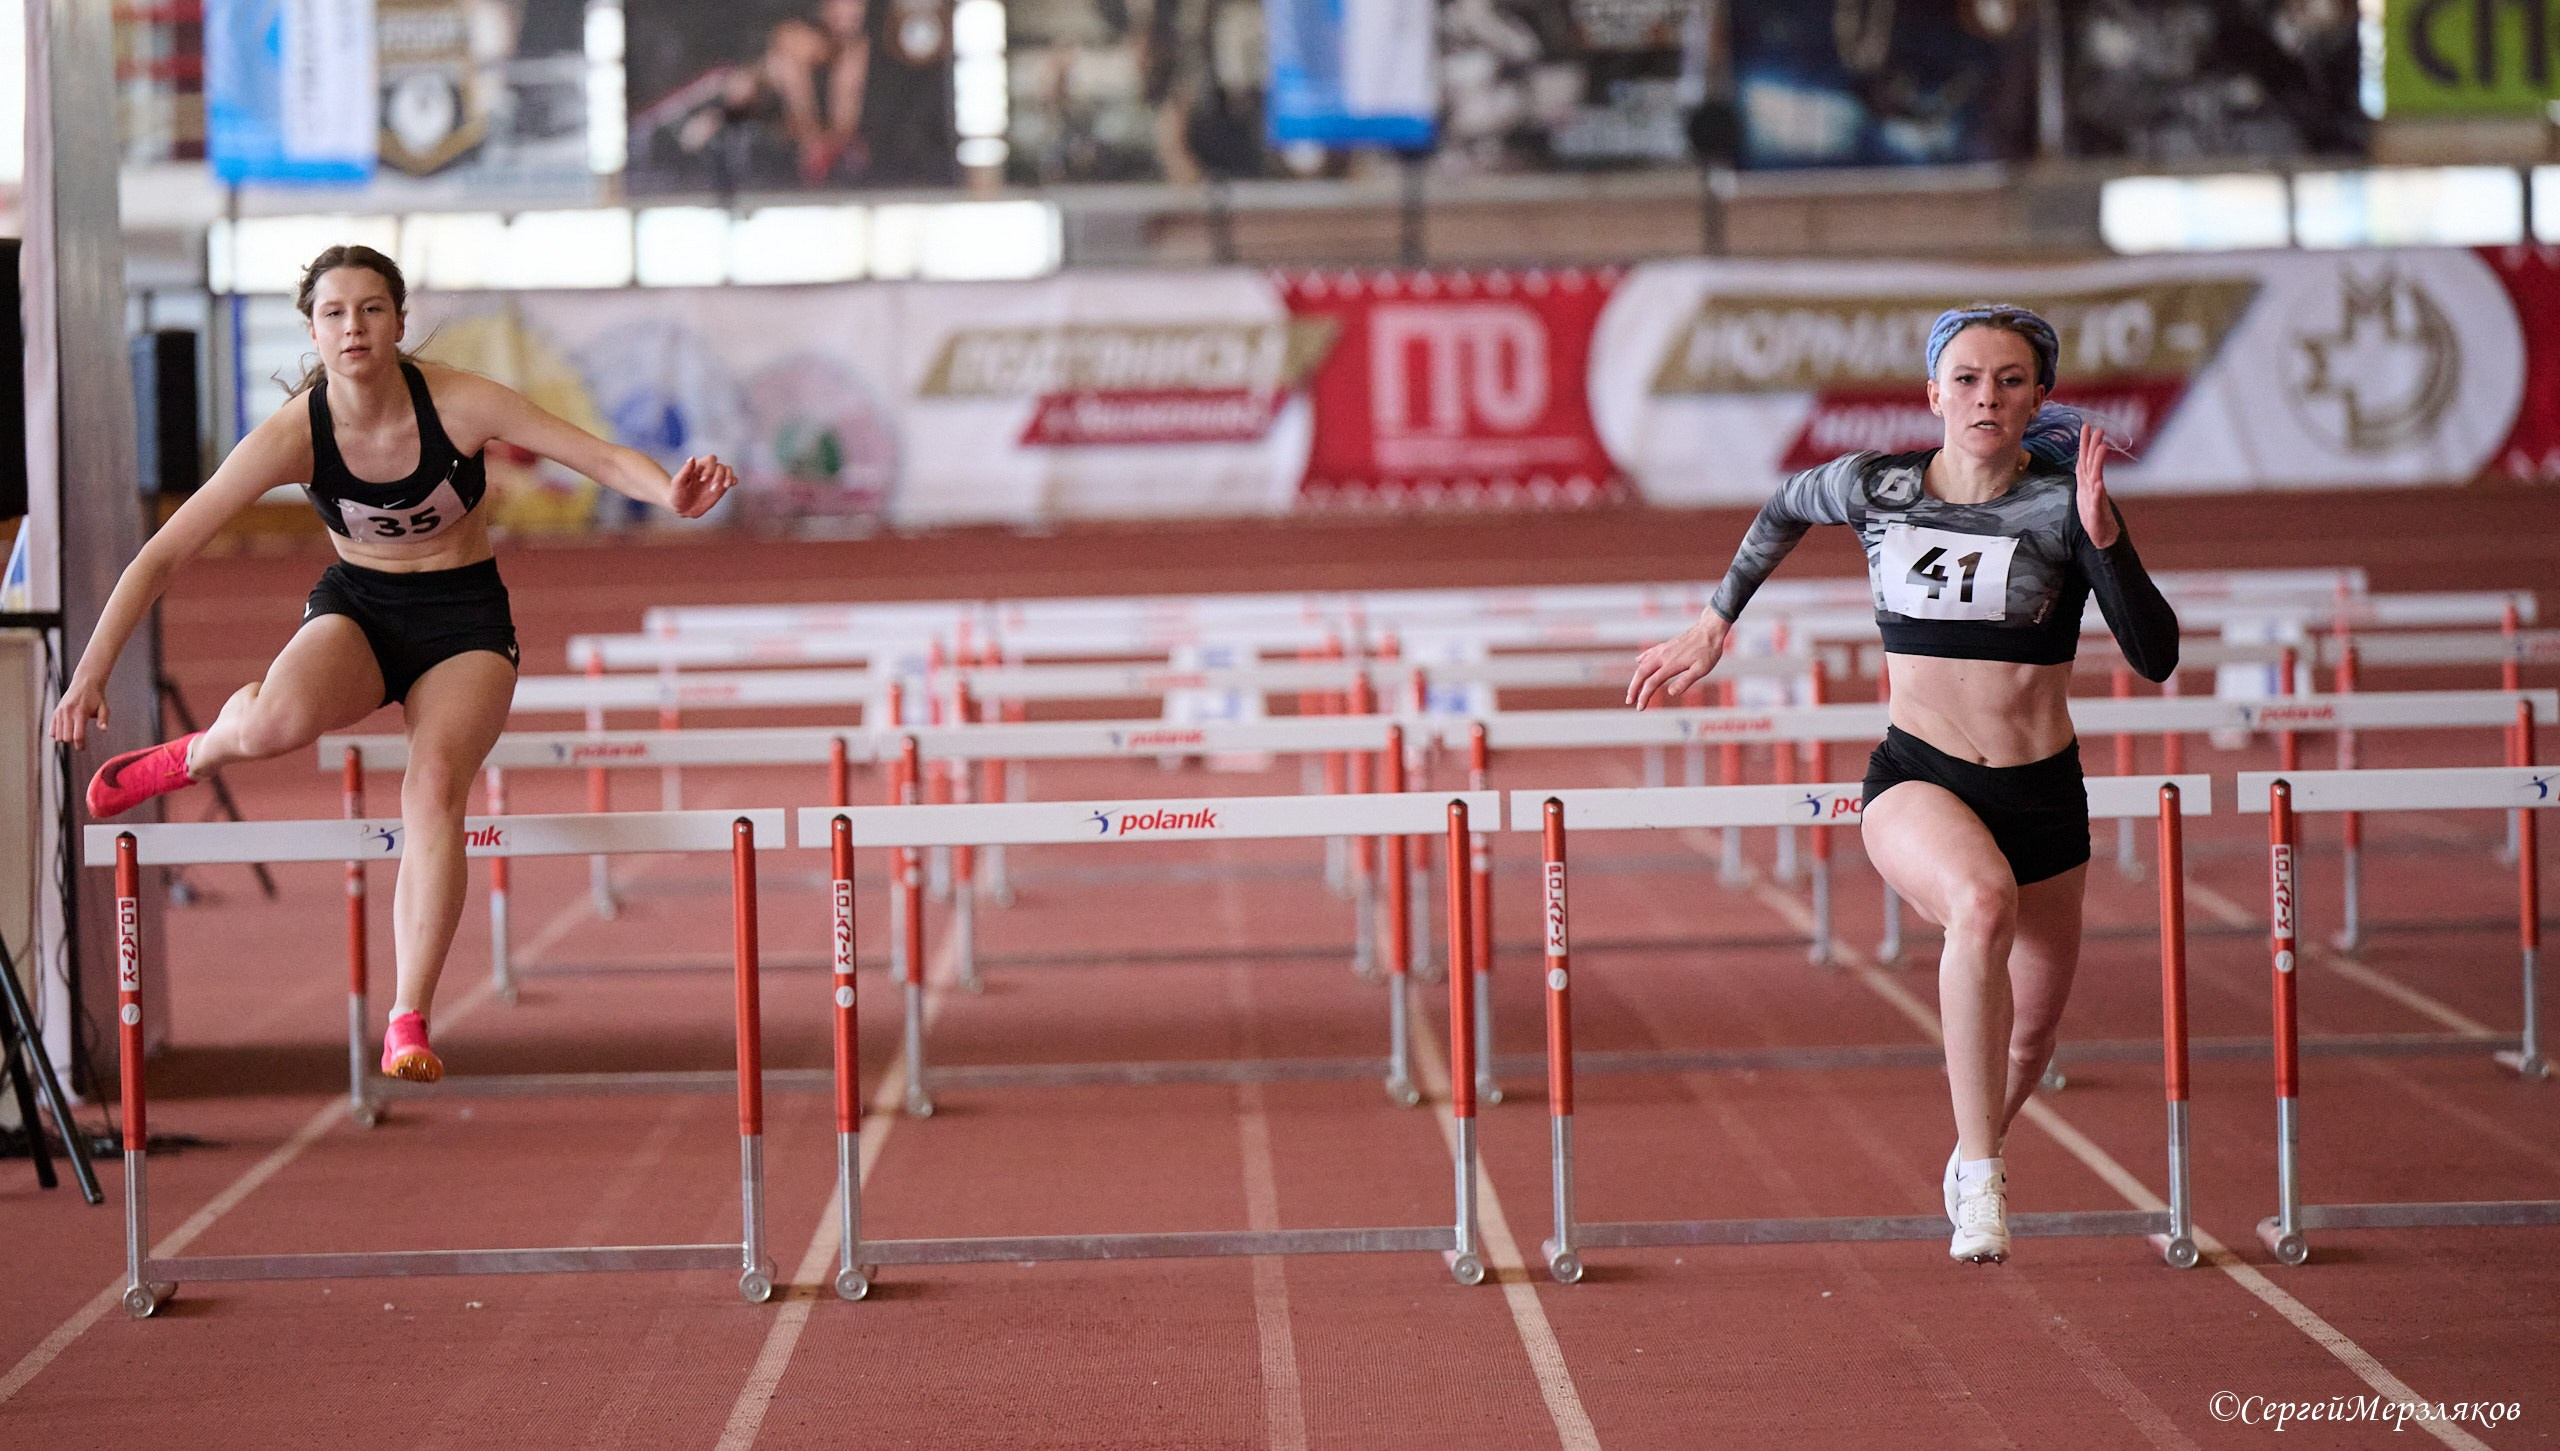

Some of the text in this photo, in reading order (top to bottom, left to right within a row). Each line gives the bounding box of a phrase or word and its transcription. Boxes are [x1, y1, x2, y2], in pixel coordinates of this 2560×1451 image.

[368, 506, 441, 538] 35
[1906, 546, 1983, 603] 41
[1119, 807, 1218, 836] polanik
[836, 882, 852, 965] POLANIK
[1548, 865, 1565, 948] POLANIK
[2275, 844, 2291, 930] POLANIK
[121, 900, 137, 983] POLANIK
